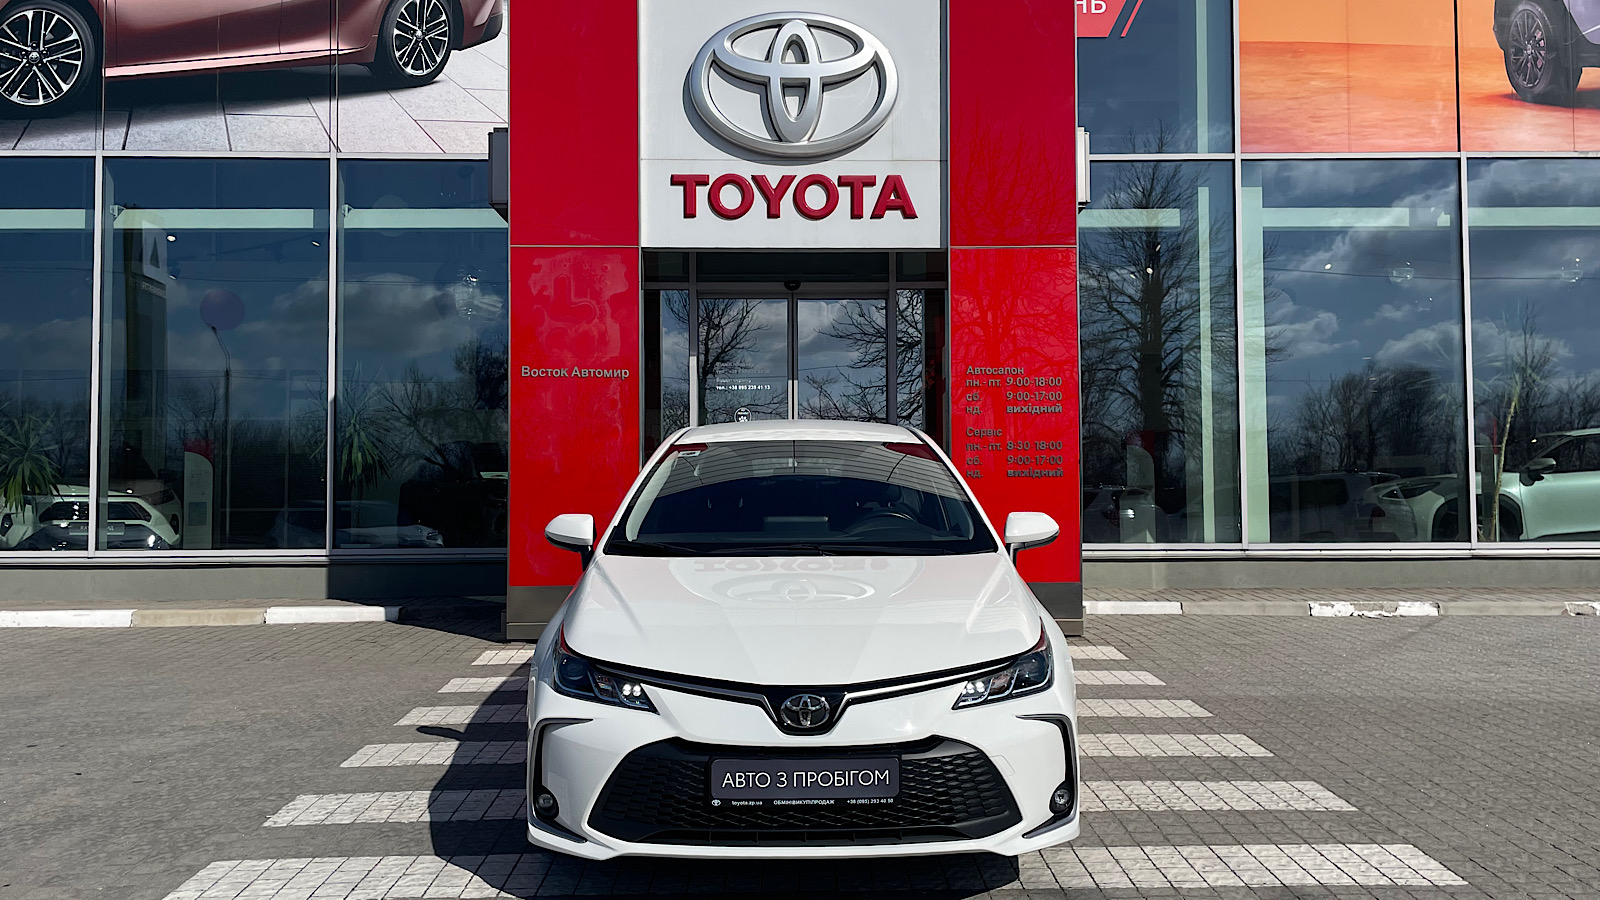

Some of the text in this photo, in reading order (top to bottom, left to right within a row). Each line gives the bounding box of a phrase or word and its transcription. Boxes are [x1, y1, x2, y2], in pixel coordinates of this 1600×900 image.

[670, 173, 918, 220] TOYOTA
[521, 365, 629, 380] Восток Автомир
[966, 365, 1024, 375] Автосалон
[966, 391, 1062, 401] сб. 9:00-17:00
[966, 404, 1063, 415] нд. вихідний
[966, 427, 1003, 438] Сервіс
[966, 455, 1063, 465] сб. 9:00-17:00
[966, 467, 1063, 478] нд. вихідний
[722, 769, 890, 788] АВТО З ПРОБІГОМ
